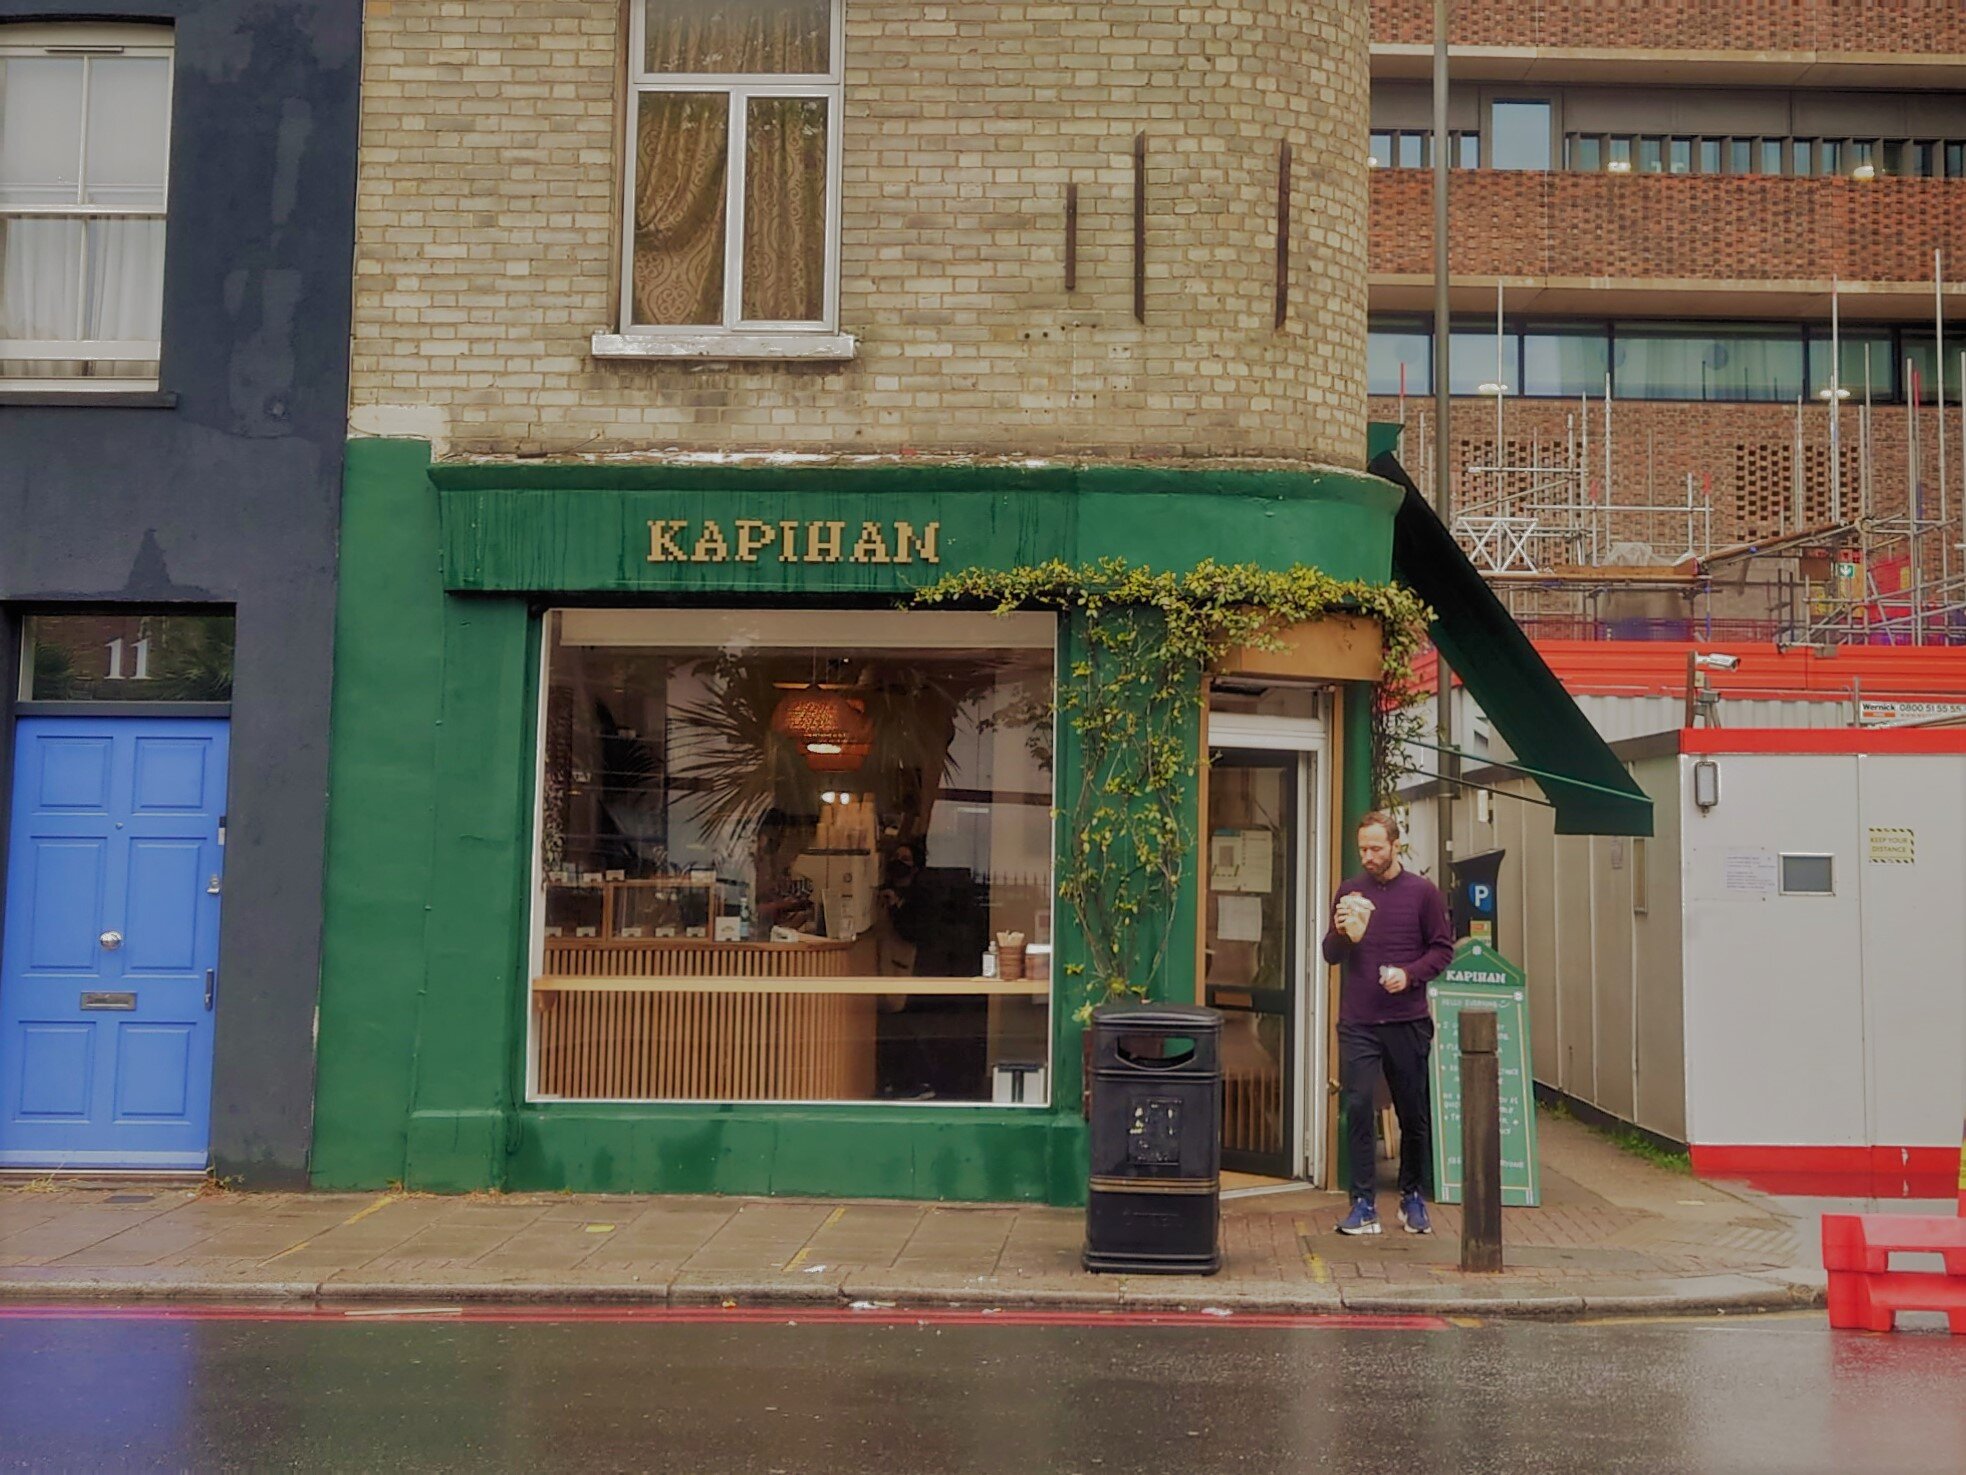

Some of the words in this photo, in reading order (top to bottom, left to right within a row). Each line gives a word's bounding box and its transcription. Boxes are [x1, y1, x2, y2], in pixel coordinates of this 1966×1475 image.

[646, 519, 940, 563] KAPIHAN
[103, 637, 152, 680] 11
[1862, 703, 1896, 711] Wernick
[1899, 703, 1924, 712] 0800
[1474, 885, 1489, 907] P
[1446, 970, 1507, 984] KAPIHAN
